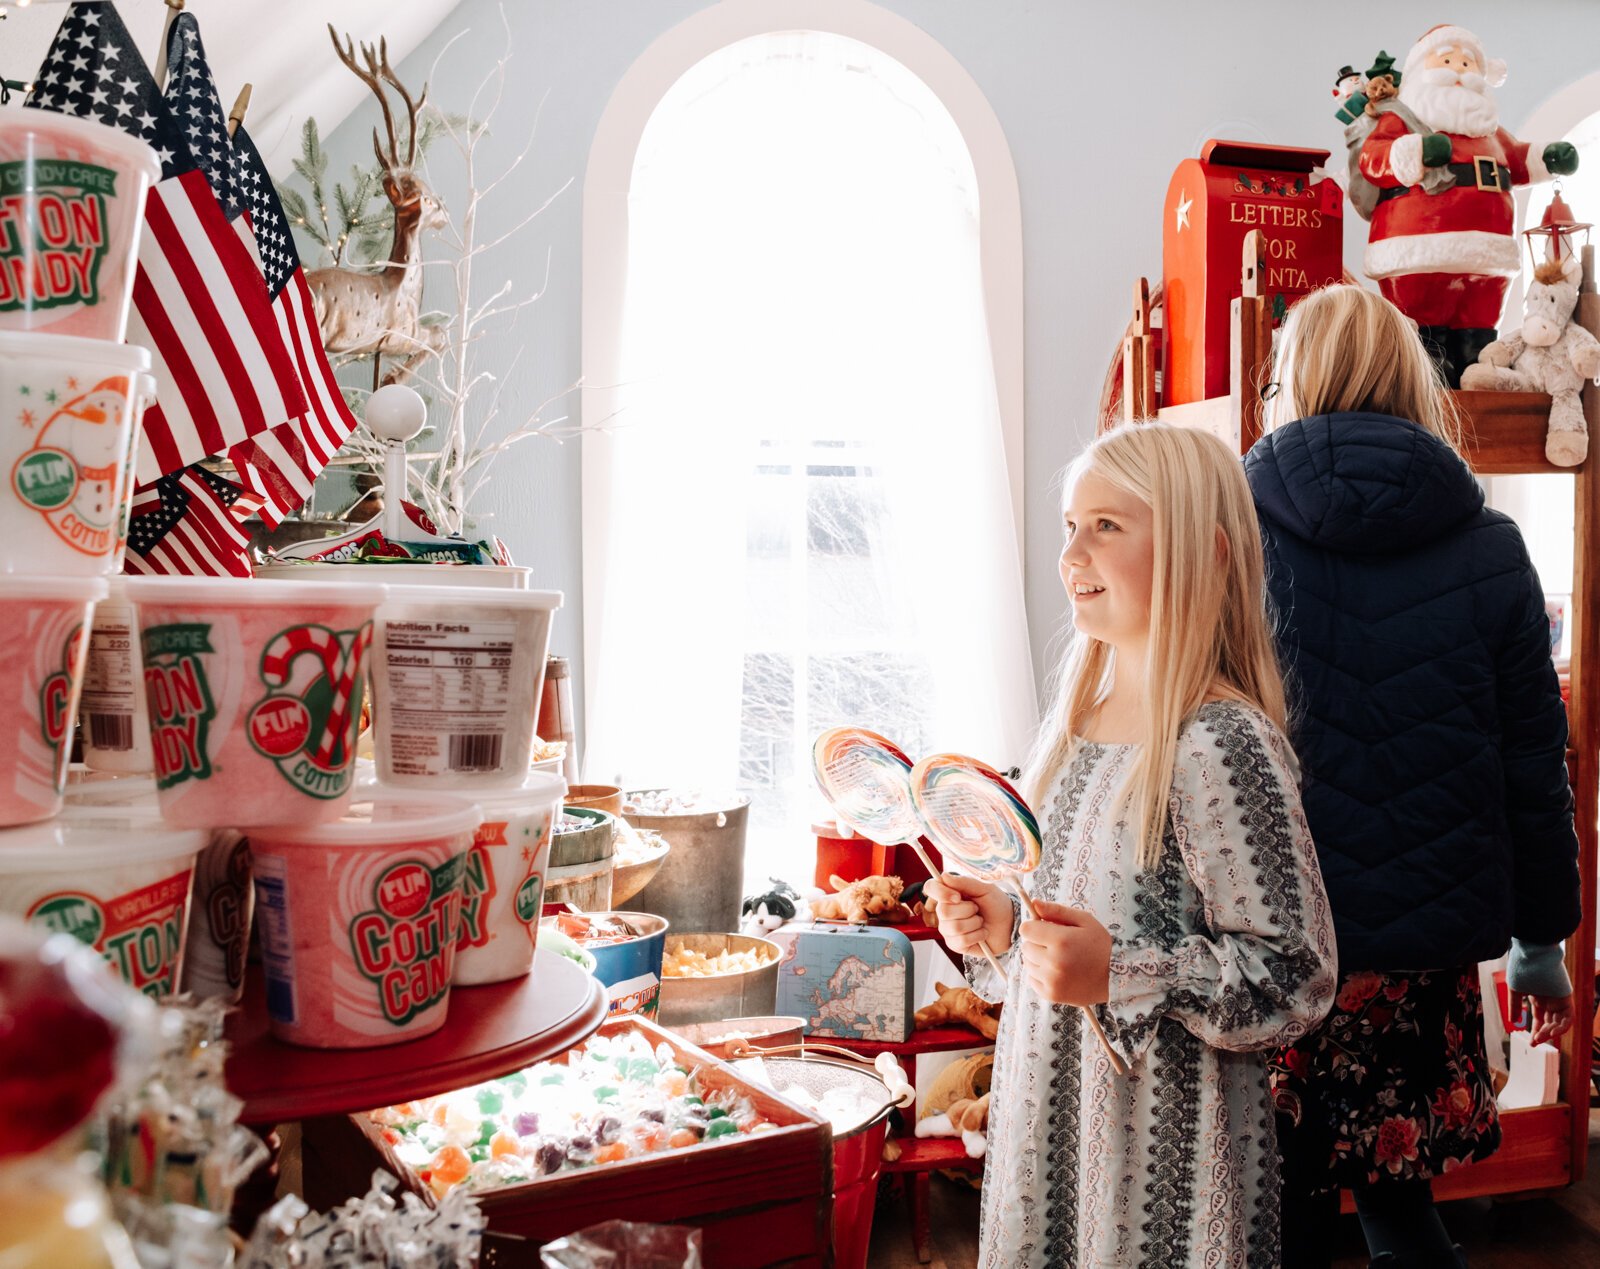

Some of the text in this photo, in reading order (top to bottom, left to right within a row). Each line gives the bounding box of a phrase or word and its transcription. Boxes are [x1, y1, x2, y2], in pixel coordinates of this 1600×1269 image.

[69, 167, 110, 190] CANE
[1229, 202, 1322, 229] LETTERS
[1268, 268, 1309, 289] NTA
[21, 459, 72, 490] FUN
[386, 621, 470, 633] Nutrition Facts
[109, 639, 130, 649] 220
[387, 654, 511, 666] Calories 110 220
[254, 702, 304, 738] FUN
[382, 866, 427, 903] FUN
[104, 904, 183, 983] TON
